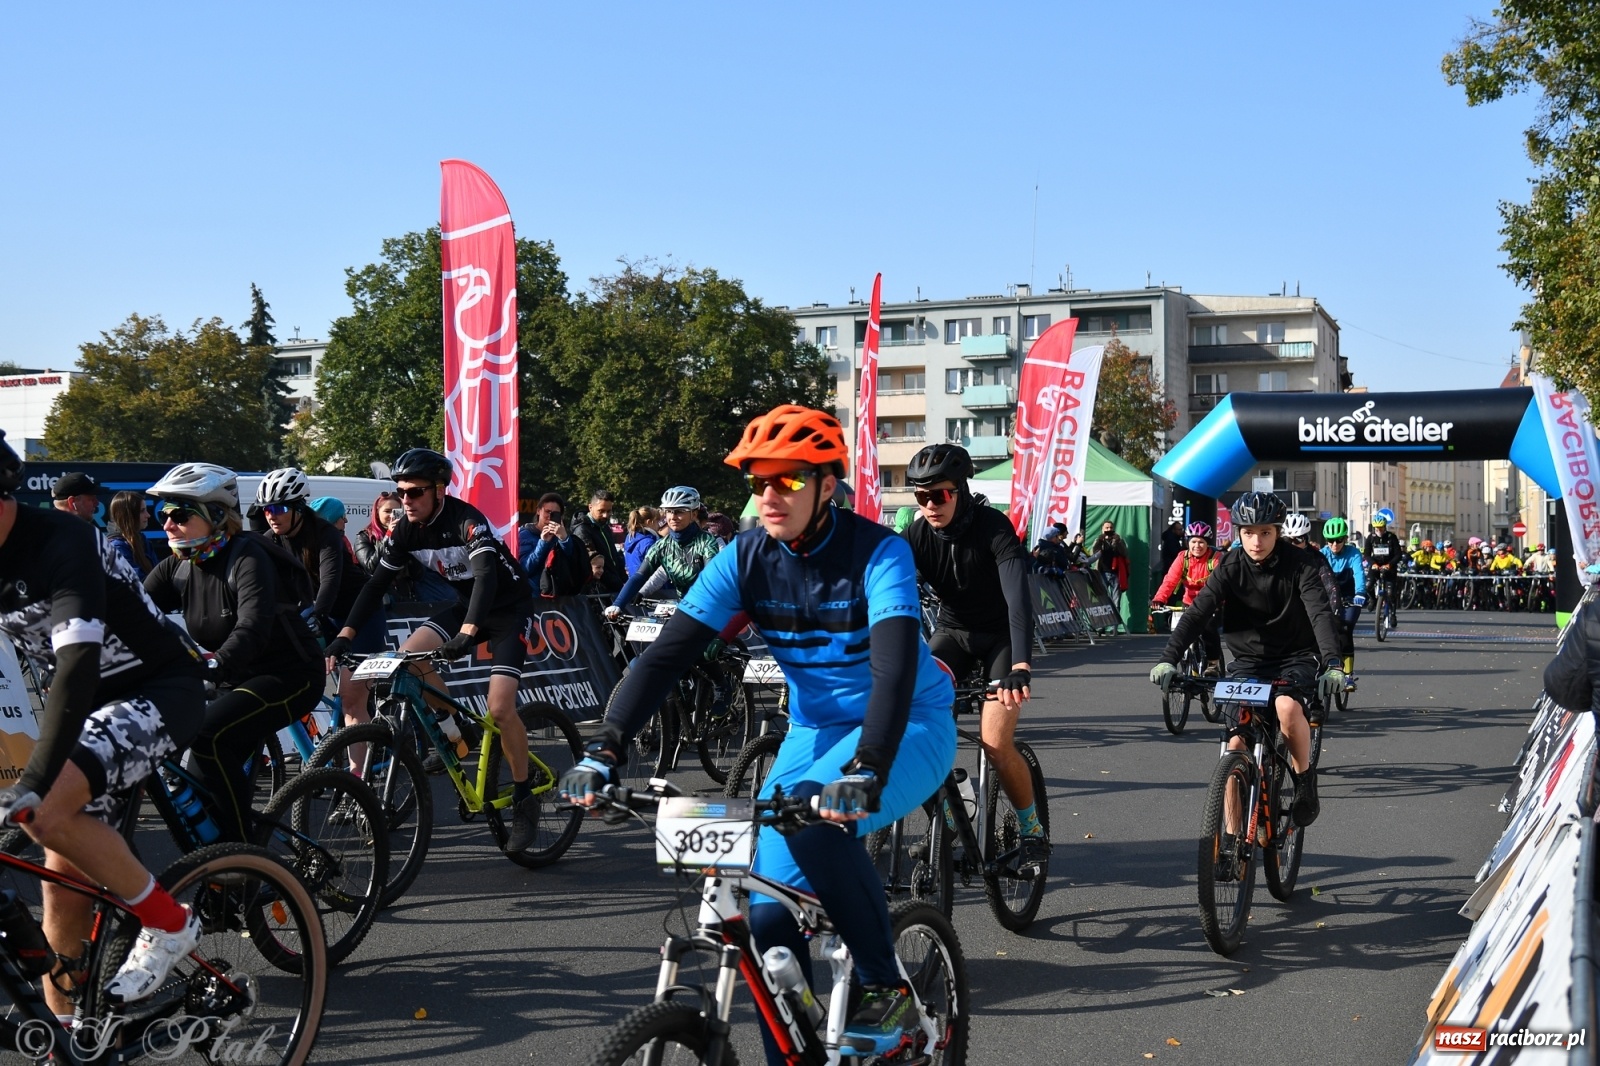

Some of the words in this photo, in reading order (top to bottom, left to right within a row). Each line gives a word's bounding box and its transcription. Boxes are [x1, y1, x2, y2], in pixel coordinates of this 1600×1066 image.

[1298, 416, 1356, 442] bike
[1363, 415, 1454, 442] atelier
[1047, 370, 1085, 527] RACIBÓRZ
[634, 625, 657, 634] 3070
[363, 661, 393, 670] 2013
[1225, 685, 1262, 695] 3147
[0, 705, 23, 718] us
[675, 830, 734, 853] 3035
